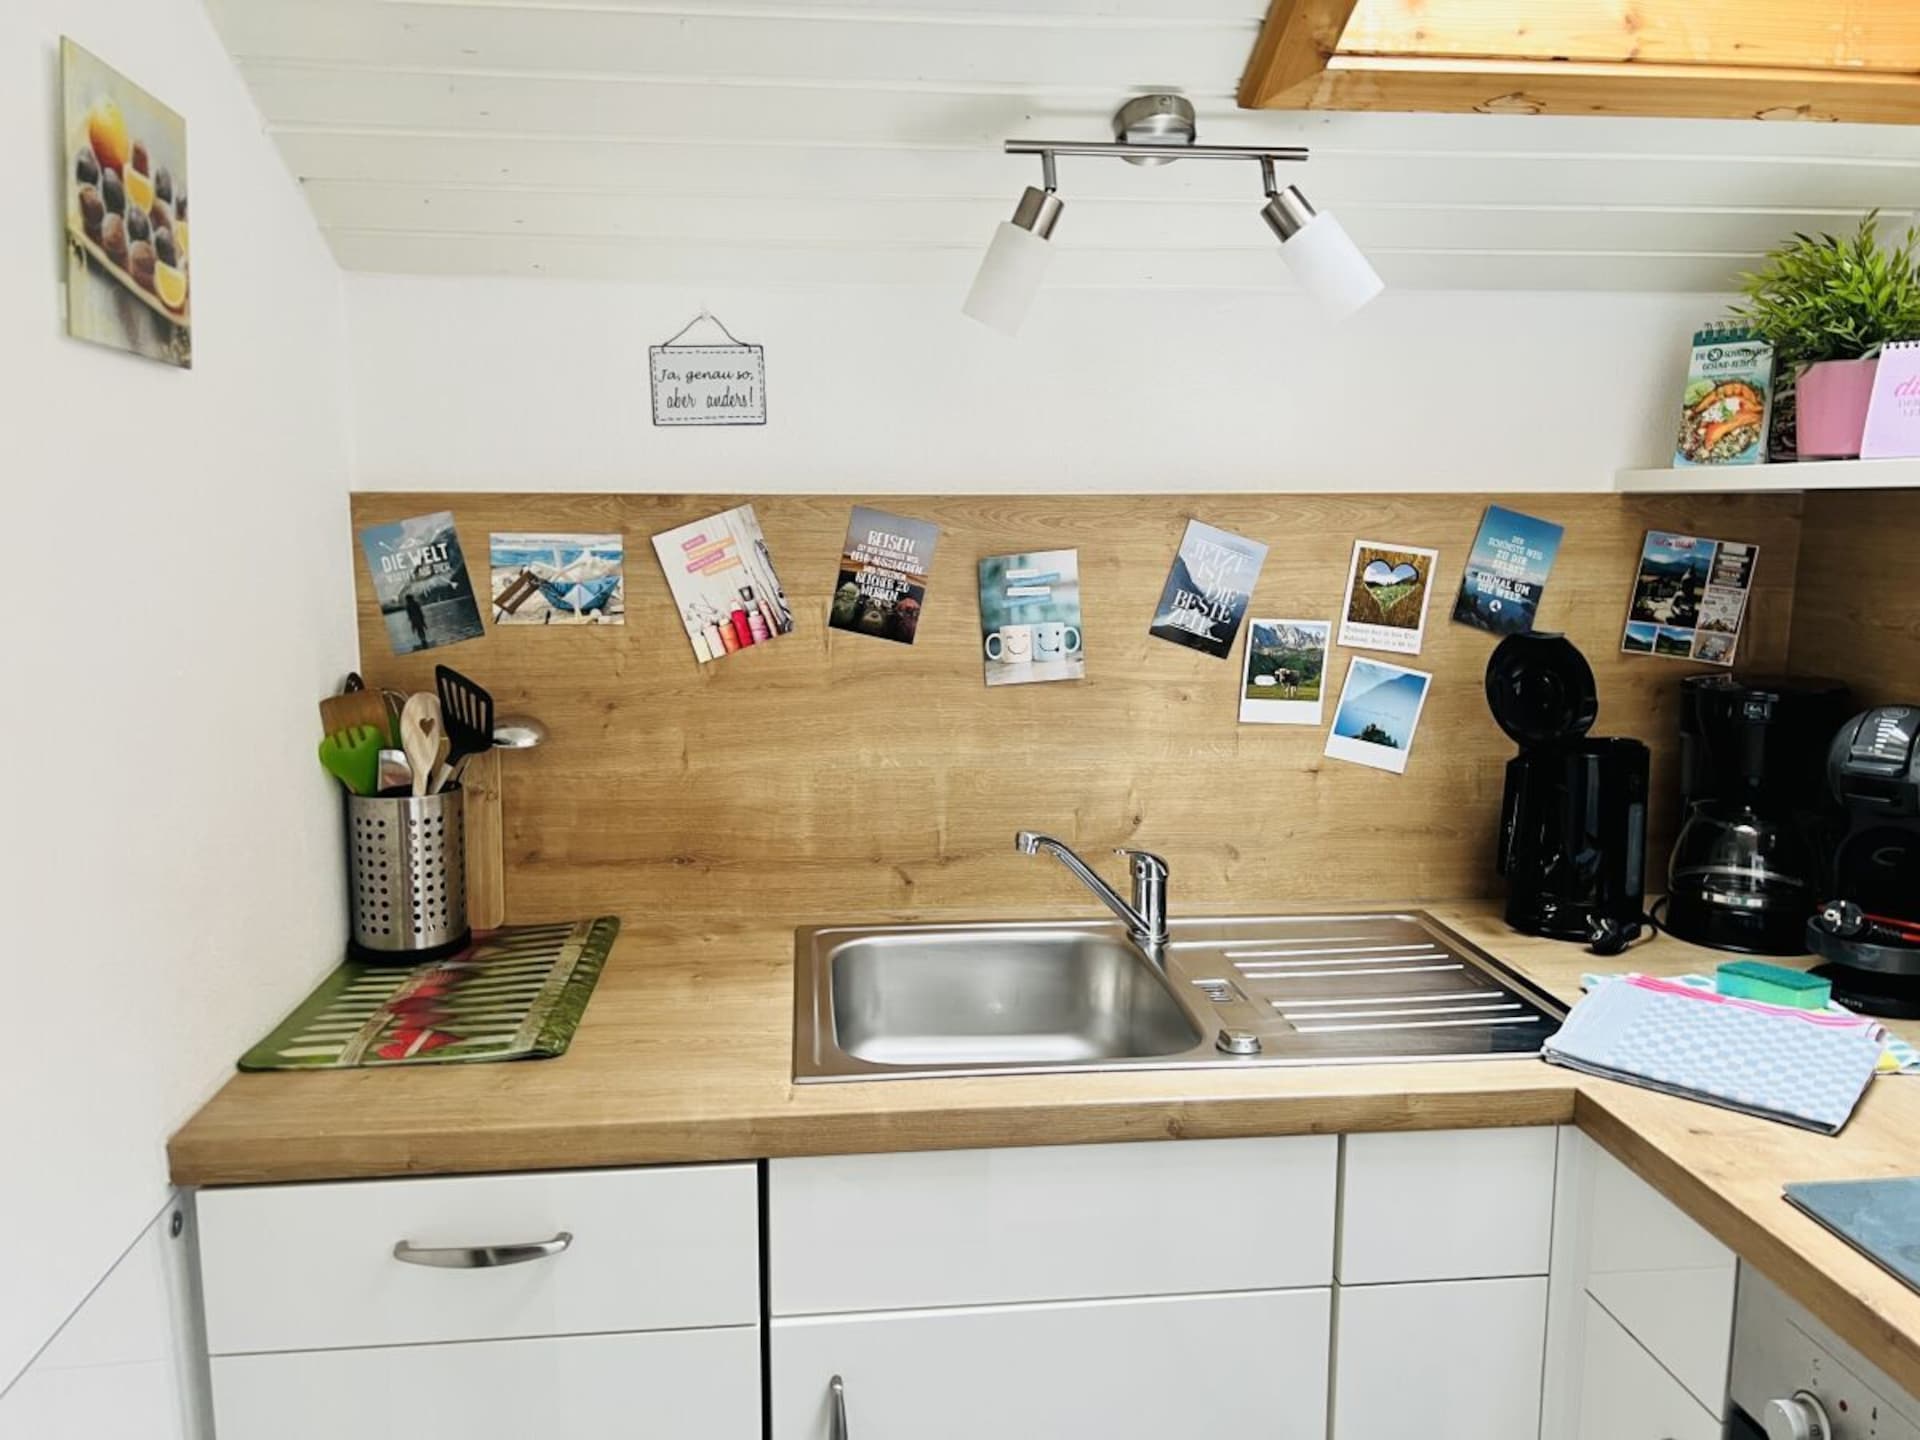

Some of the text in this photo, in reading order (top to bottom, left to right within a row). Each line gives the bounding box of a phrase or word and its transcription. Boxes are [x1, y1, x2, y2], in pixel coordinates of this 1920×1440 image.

[658, 368, 754, 384] Ja, genau so,
[666, 386, 753, 408] aber anders!
[382, 543, 448, 573] DIE WELT
[1207, 583, 1239, 609] DIE
[1515, 584, 1531, 596] UM
[1173, 588, 1234, 624] BESTE
